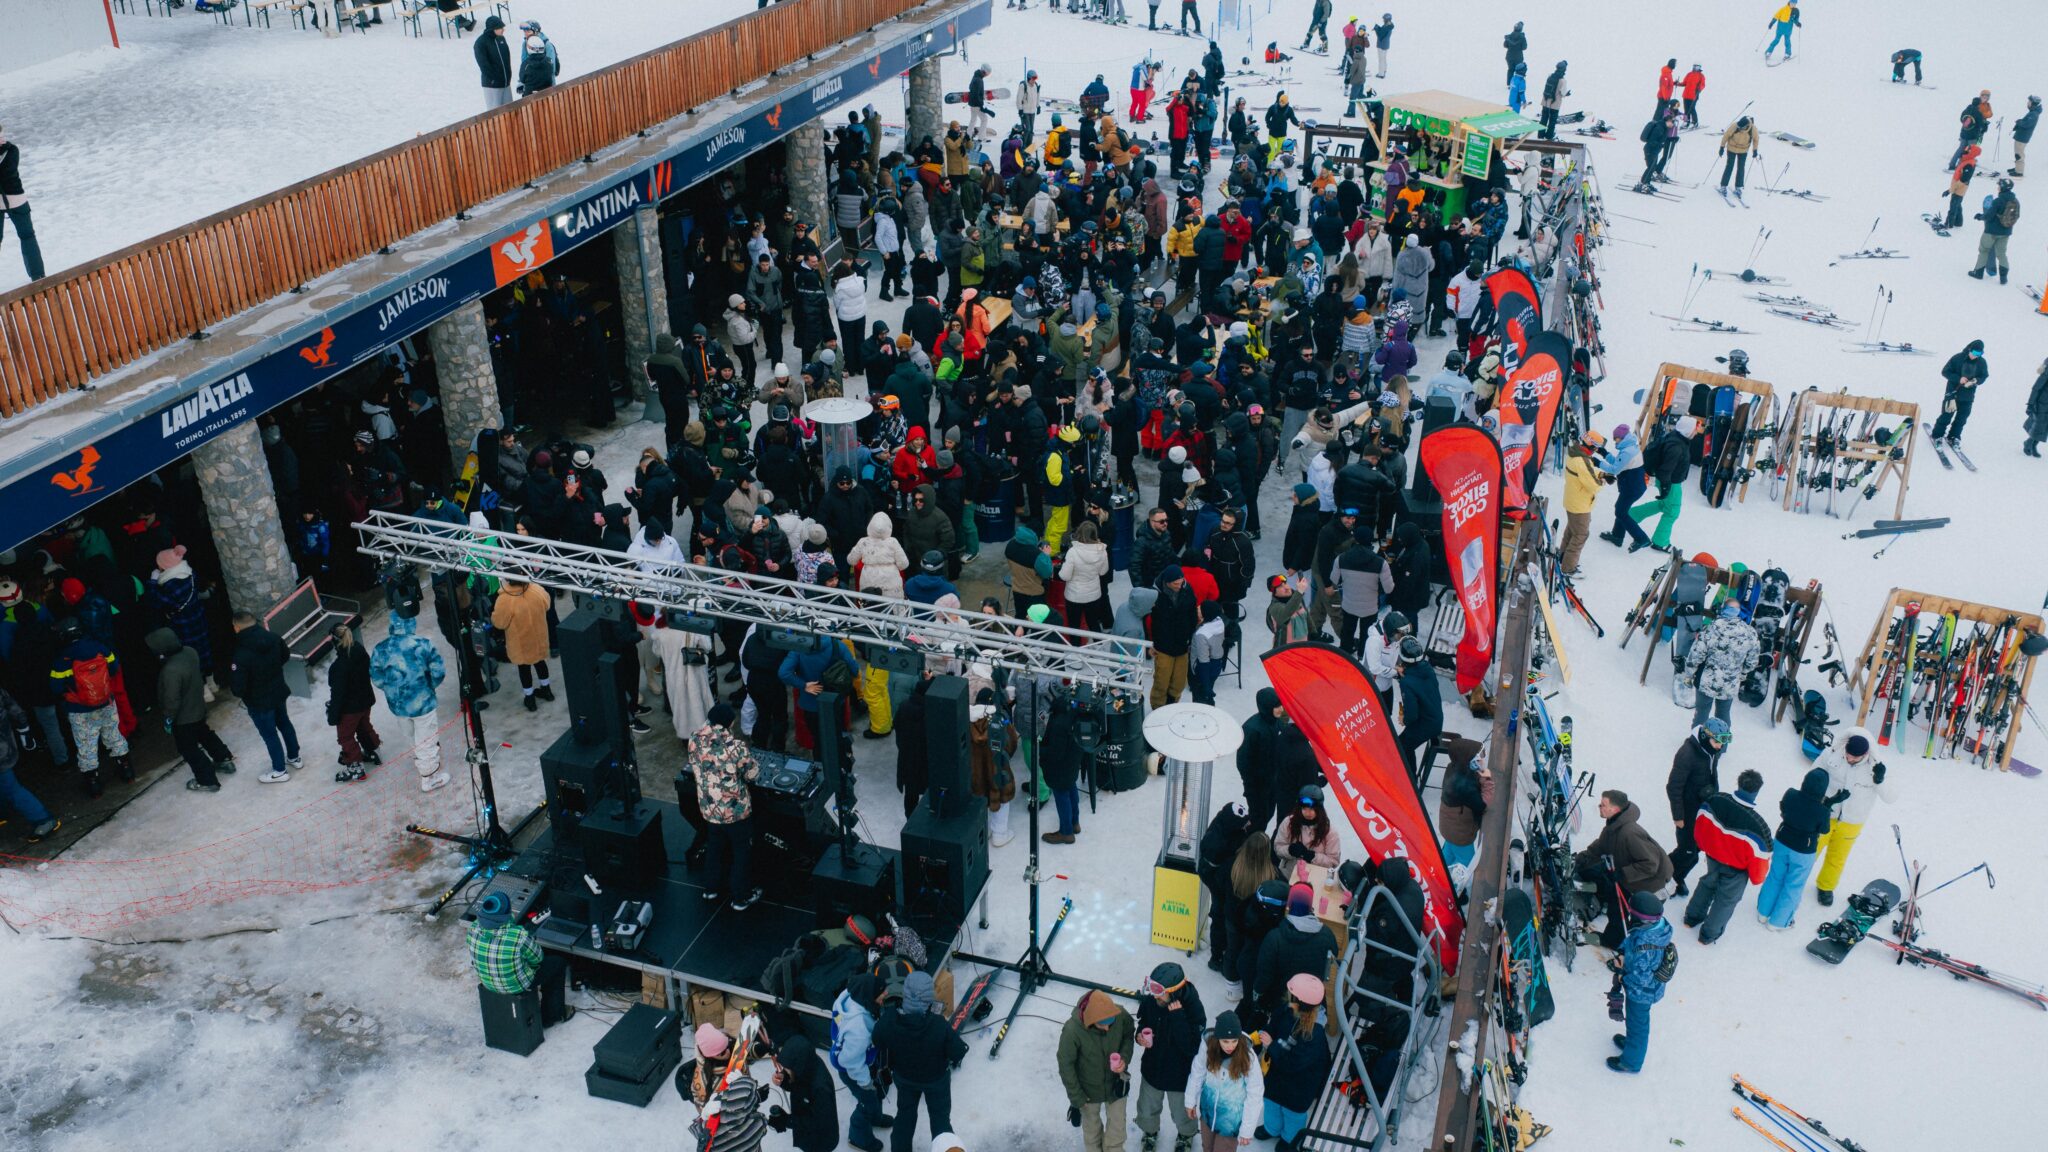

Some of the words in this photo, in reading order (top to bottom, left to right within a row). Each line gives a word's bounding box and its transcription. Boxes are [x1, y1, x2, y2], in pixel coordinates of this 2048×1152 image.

[812, 75, 843, 104] LAVAZZA
[1390, 107, 1451, 136] crocs
[706, 127, 745, 162] JAMESON
[563, 180, 641, 238] CANTINA
[378, 277, 448, 331] JAMESON
[161, 372, 255, 439] LAVAZZA
[231, 408, 247, 424] 1895
